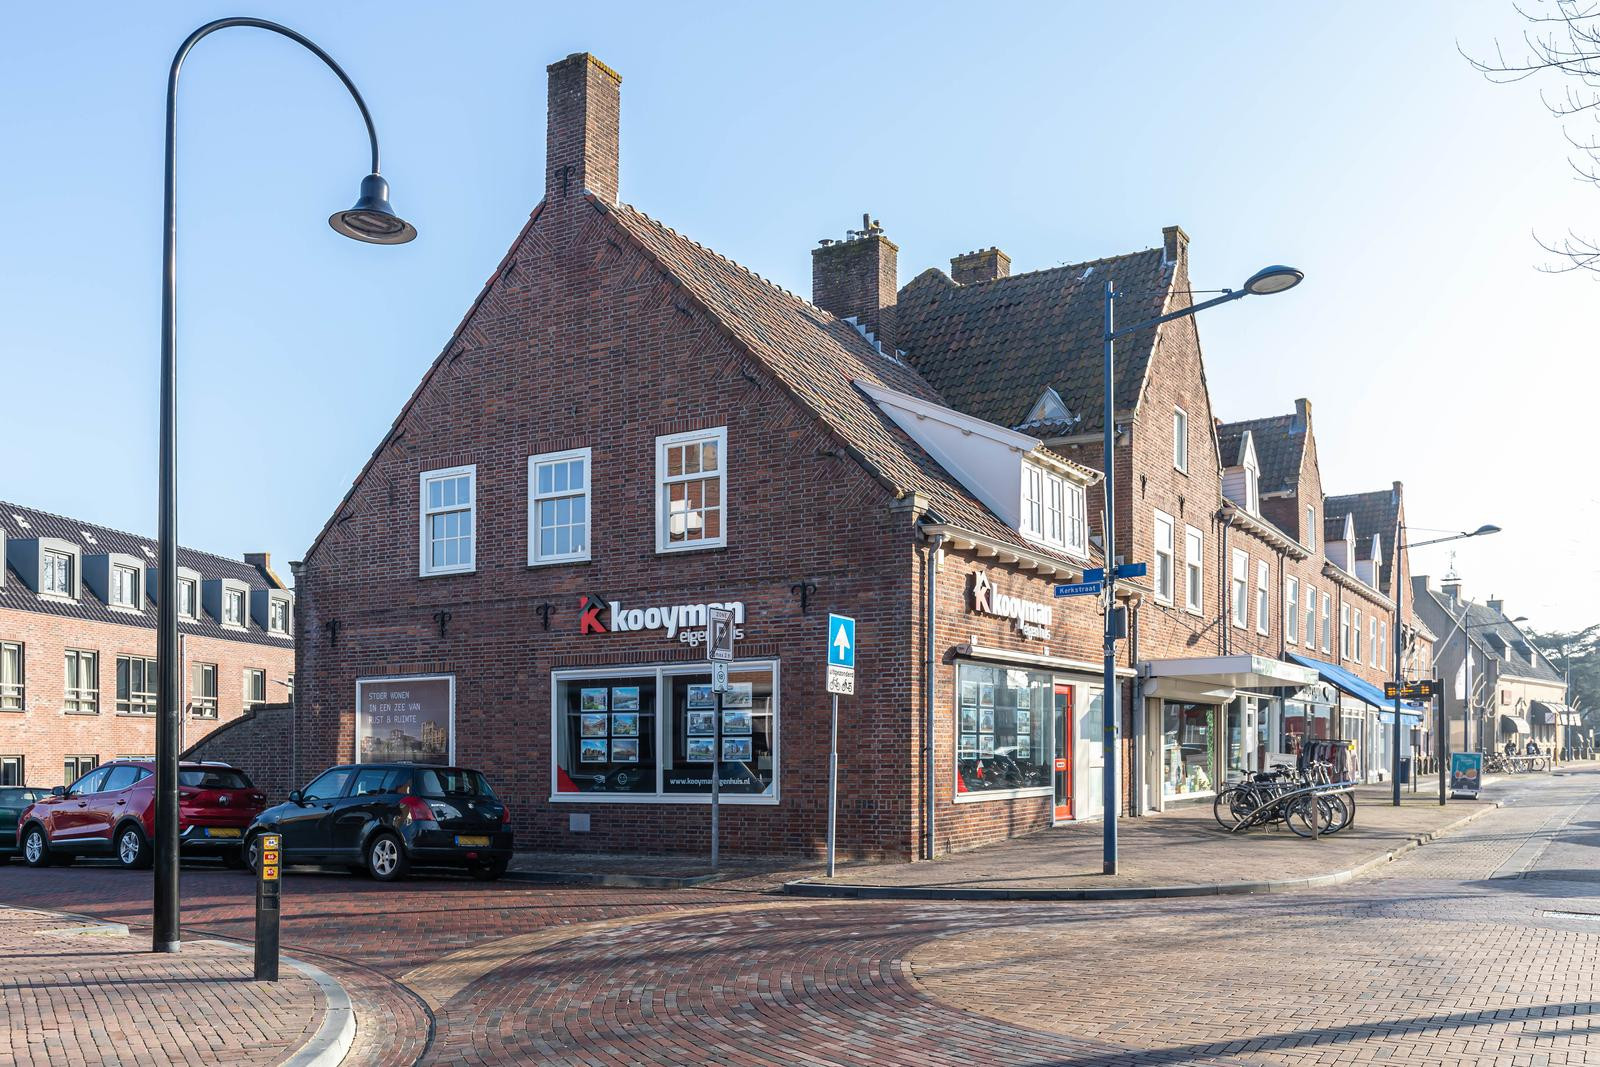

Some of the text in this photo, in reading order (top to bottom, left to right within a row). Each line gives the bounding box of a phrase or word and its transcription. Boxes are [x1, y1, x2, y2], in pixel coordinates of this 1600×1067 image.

[1059, 585, 1096, 594] Kerkstraat
[992, 583, 1052, 630] kooyman
[608, 601, 745, 639] kooymn
[368, 691, 410, 700] STOER WONEN
[369, 703, 421, 712] IN EEN ZEE VAN
[368, 716, 384, 724] RUST
[394, 715, 417, 723] RUIMTE
